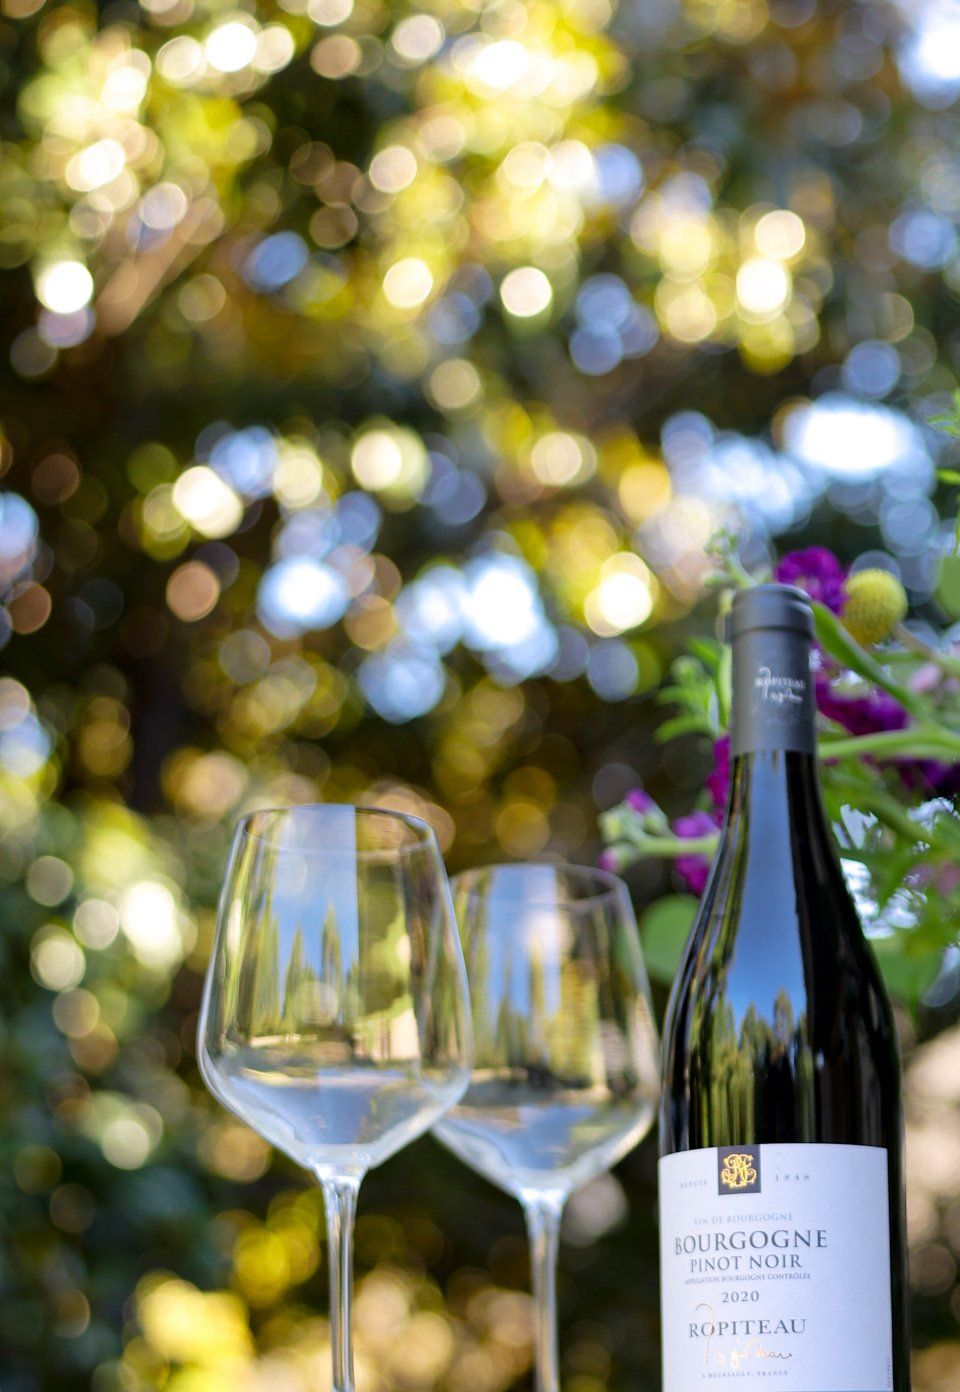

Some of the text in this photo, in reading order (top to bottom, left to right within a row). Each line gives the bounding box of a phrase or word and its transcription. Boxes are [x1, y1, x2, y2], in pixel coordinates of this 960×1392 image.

[754, 675, 806, 688] ROPITEAU
[693, 1212, 794, 1226] VIN DE BOURGOGNE
[675, 1229, 828, 1255] BOURGOGNE
[690, 1254, 802, 1273] PINOT NOIR
[685, 1276, 720, 1285] APPELLATION
[721, 1274, 766, 1282] BOURGOGNE
[721, 1290, 760, 1303] 2020
[688, 1319, 807, 1338] ROPITEAU
